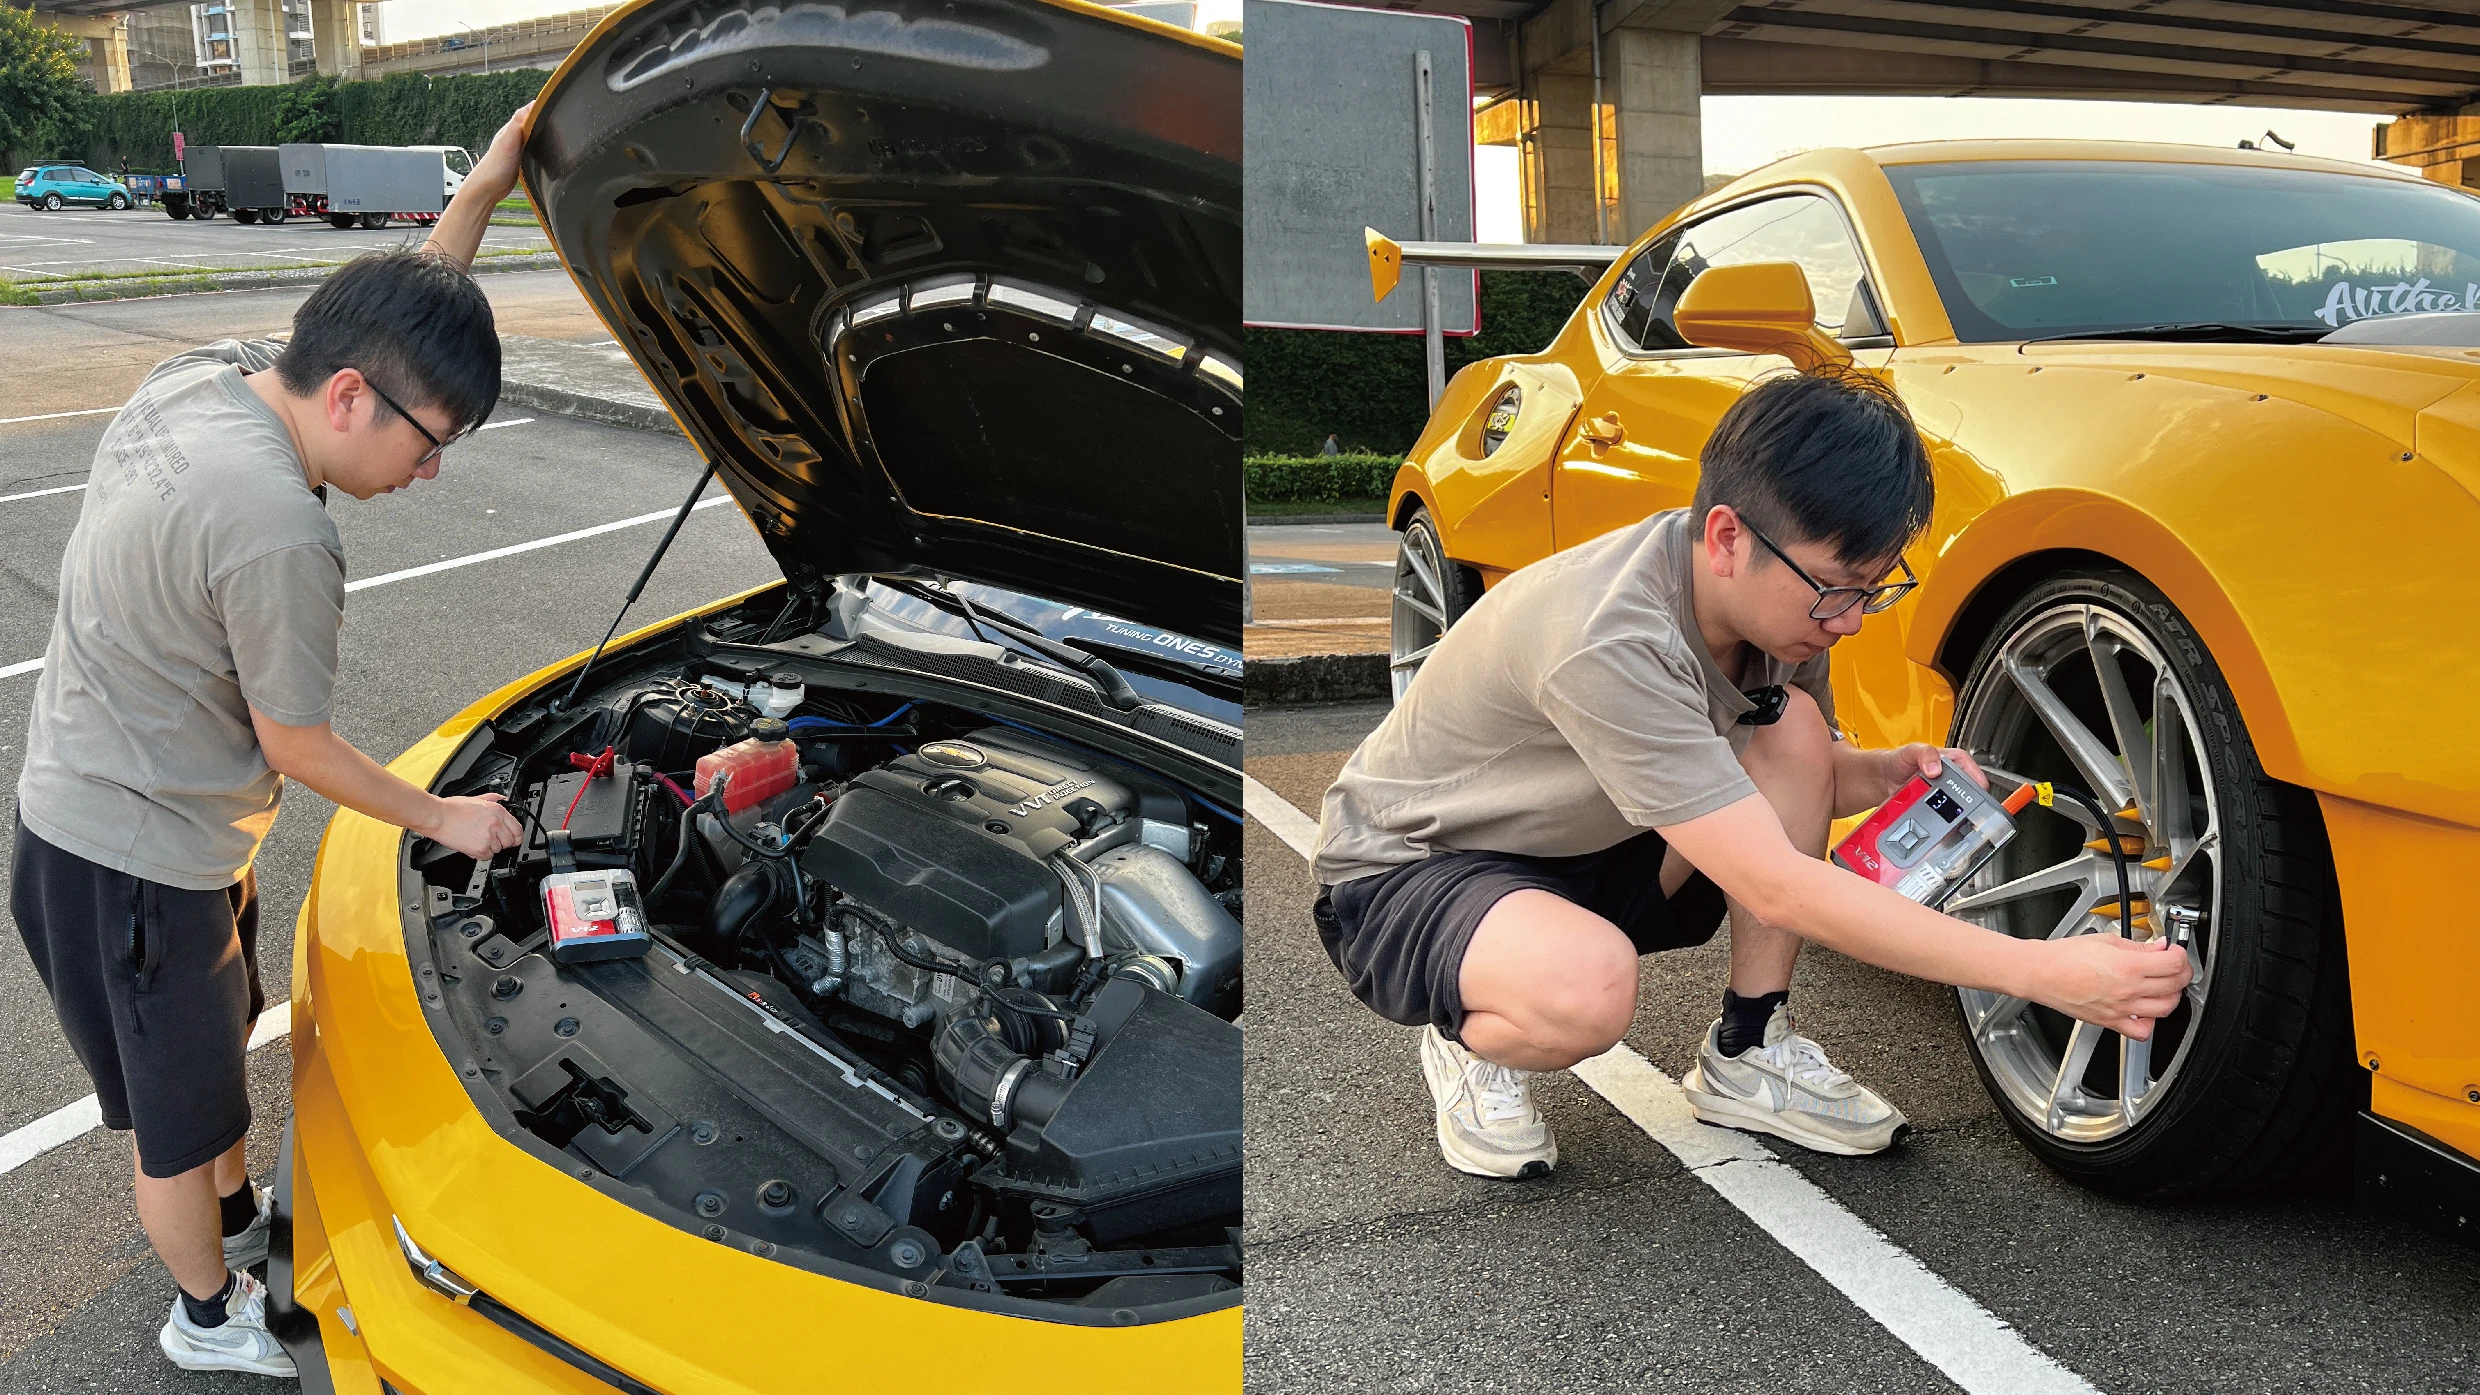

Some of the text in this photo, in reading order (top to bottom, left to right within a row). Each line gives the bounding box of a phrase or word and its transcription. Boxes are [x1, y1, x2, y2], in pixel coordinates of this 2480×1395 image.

[1106, 623, 1153, 641] TUNING
[1152, 632, 1221, 659] ONES
[1048, 780, 1078, 796] DIRECT
[1053, 779, 1096, 801] INJECTION
[1008, 792, 1053, 817] VVT
[1854, 846, 1878, 870] V12
[571, 925, 599, 933] V12
